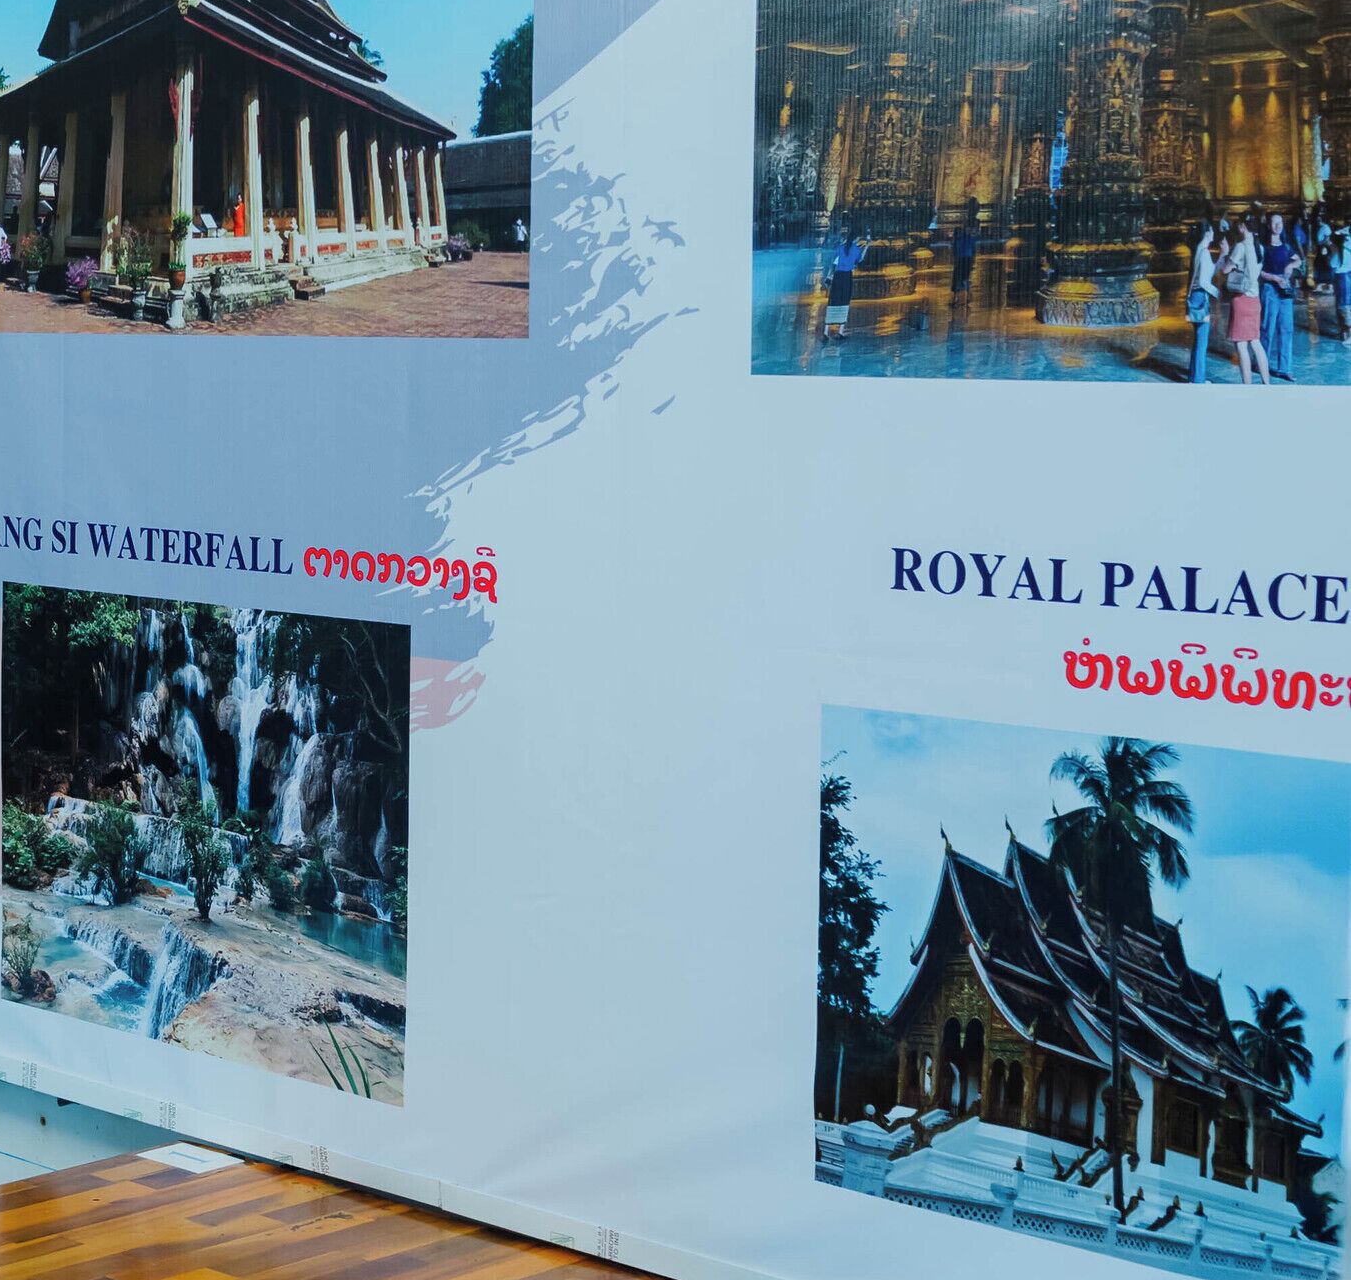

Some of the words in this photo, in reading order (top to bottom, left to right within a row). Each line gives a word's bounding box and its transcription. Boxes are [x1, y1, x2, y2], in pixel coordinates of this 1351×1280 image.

[50, 520, 80, 556] SI
[88, 522, 294, 576] WATERFALL
[889, 547, 1084, 605] ROYAL
[1098, 561, 1350, 625] PALACE
[1063, 637, 1351, 712] ຫໍພພິພິທະ
